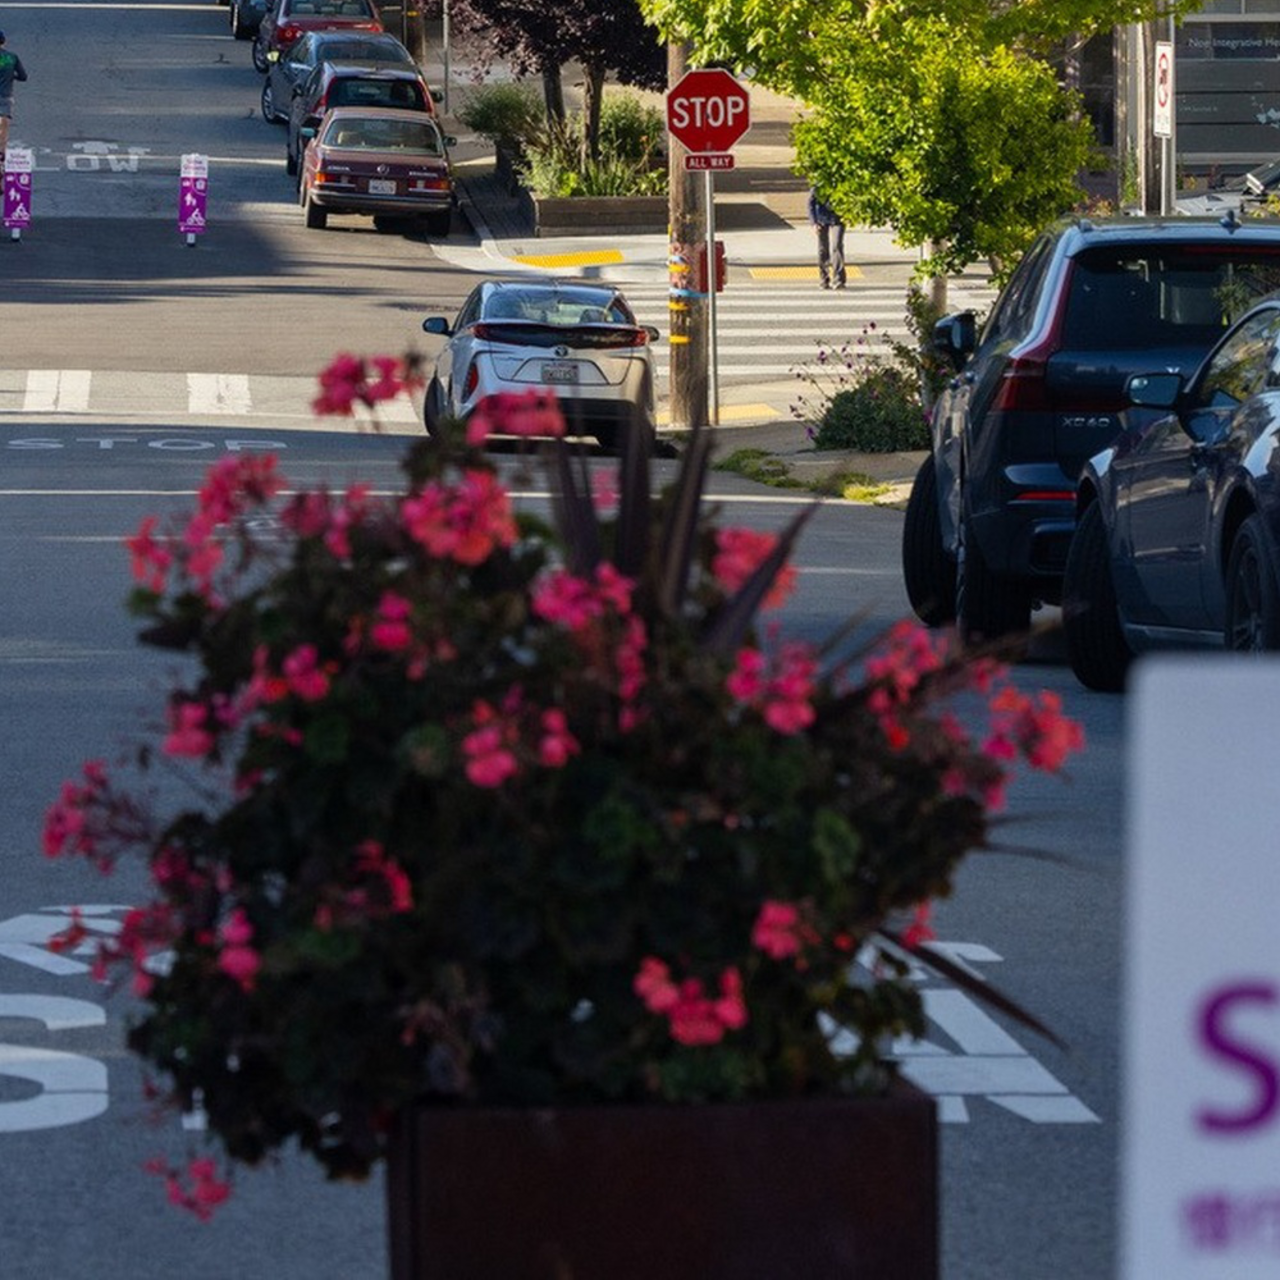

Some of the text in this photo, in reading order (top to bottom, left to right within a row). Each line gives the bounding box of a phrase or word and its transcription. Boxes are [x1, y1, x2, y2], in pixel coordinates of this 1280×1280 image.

[672, 96, 744, 129] STOP
[689, 157, 730, 168] ALL WAY
